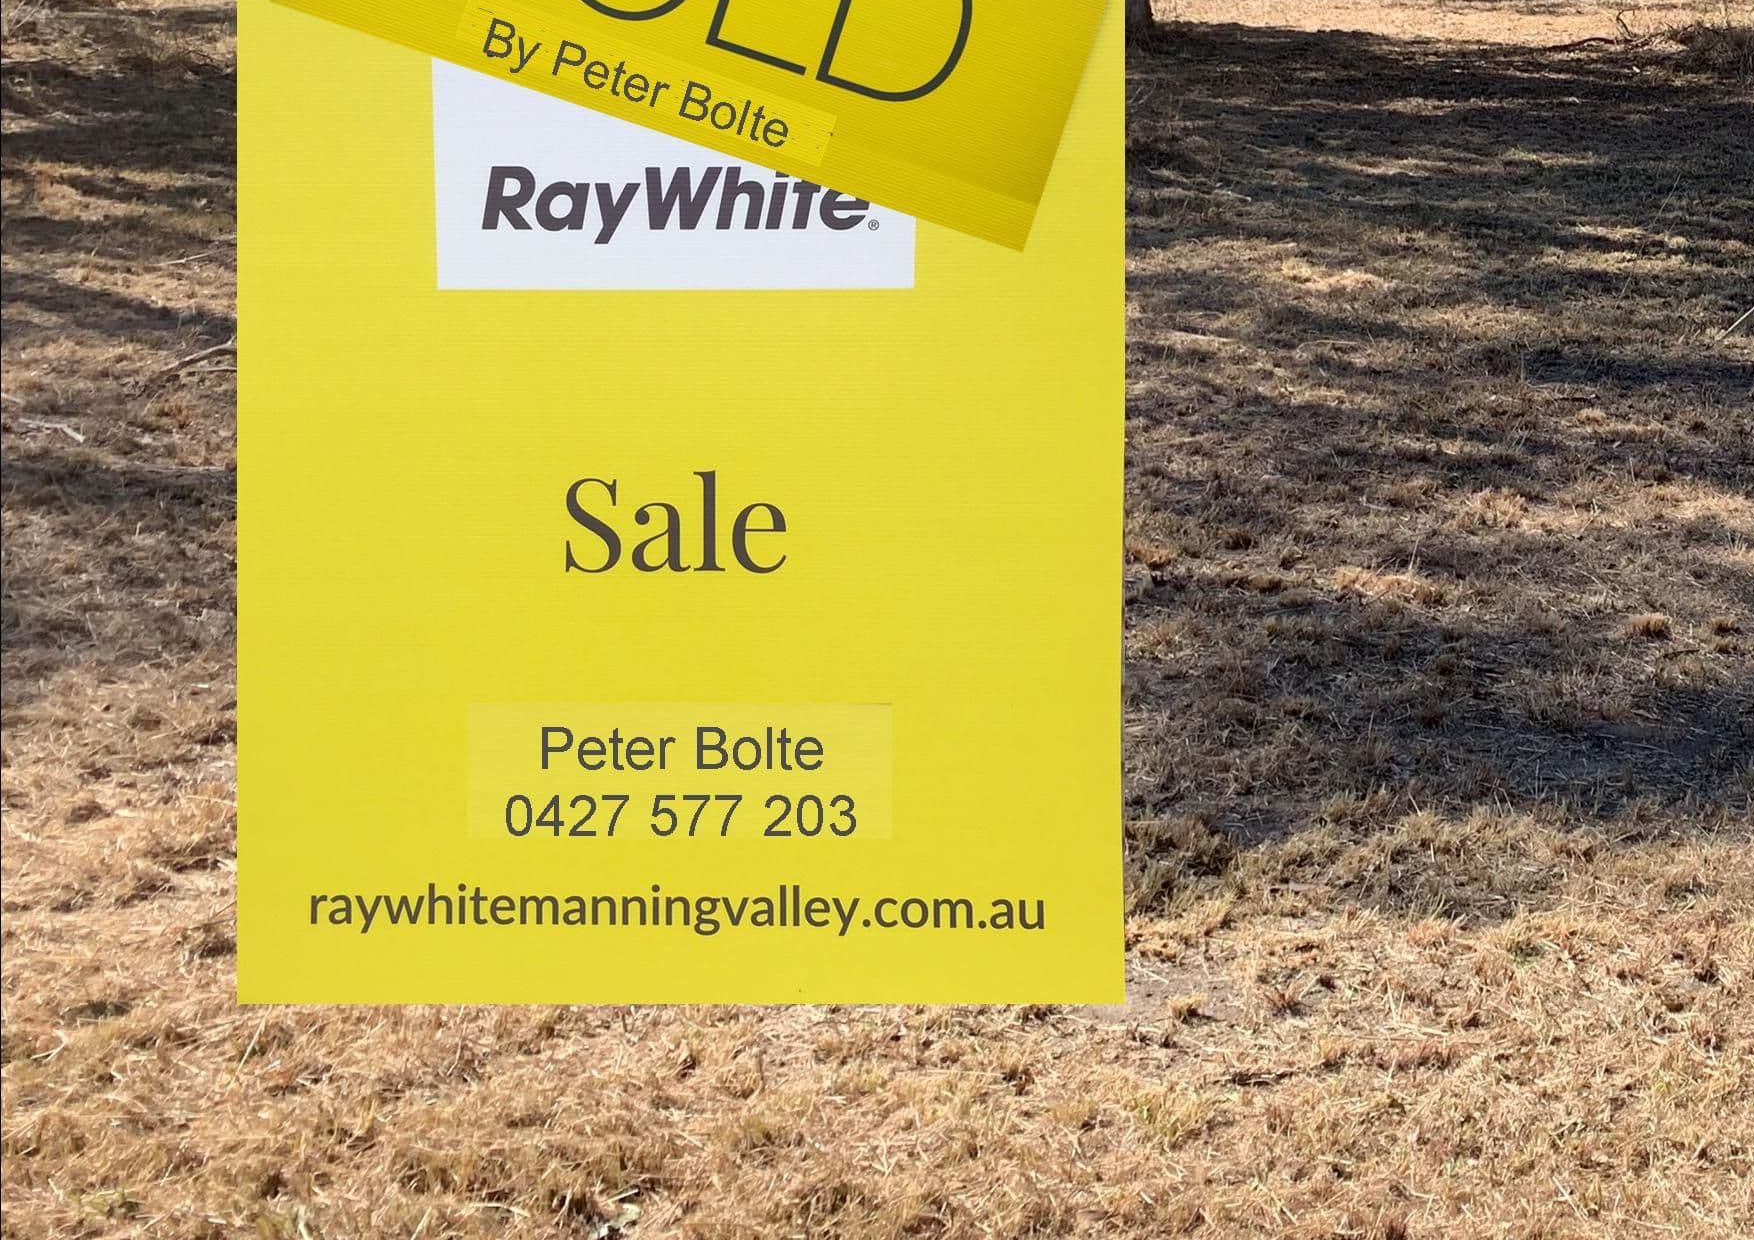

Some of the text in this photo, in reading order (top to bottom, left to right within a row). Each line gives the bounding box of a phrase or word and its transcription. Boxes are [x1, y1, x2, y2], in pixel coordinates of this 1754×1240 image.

[482, 17, 789, 148] By Peter Bolte
[565, 470, 788, 574] Sale
[541, 726, 824, 771] Peter Bolte
[505, 794, 857, 837] 0427 577 203
[310, 882, 1045, 937] raywhitemanningvalley.com.au
